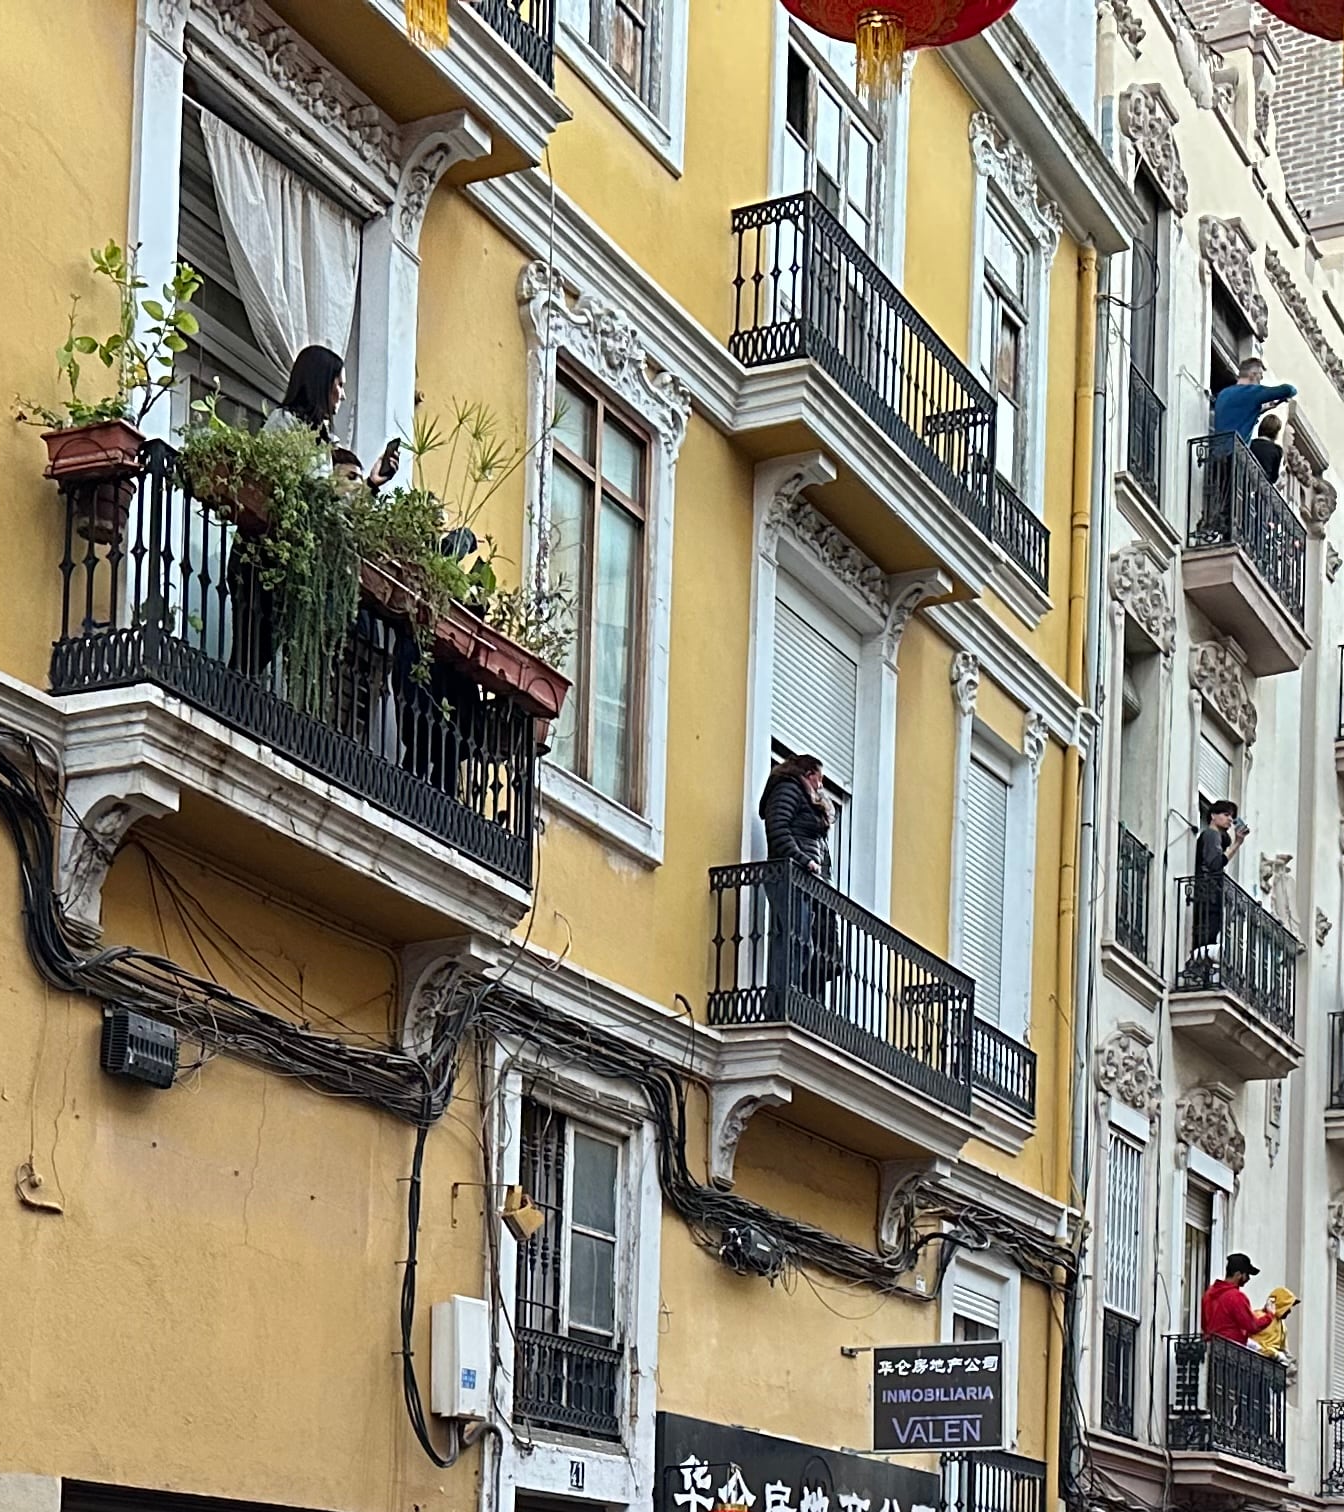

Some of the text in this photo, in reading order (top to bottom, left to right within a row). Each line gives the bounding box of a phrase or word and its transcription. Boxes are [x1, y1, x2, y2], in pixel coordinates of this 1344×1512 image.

[882, 1386, 994, 1403] INMOBILIARIA
[891, 1414, 983, 1444] VALEN
[571, 1461, 583, 1487] 41
